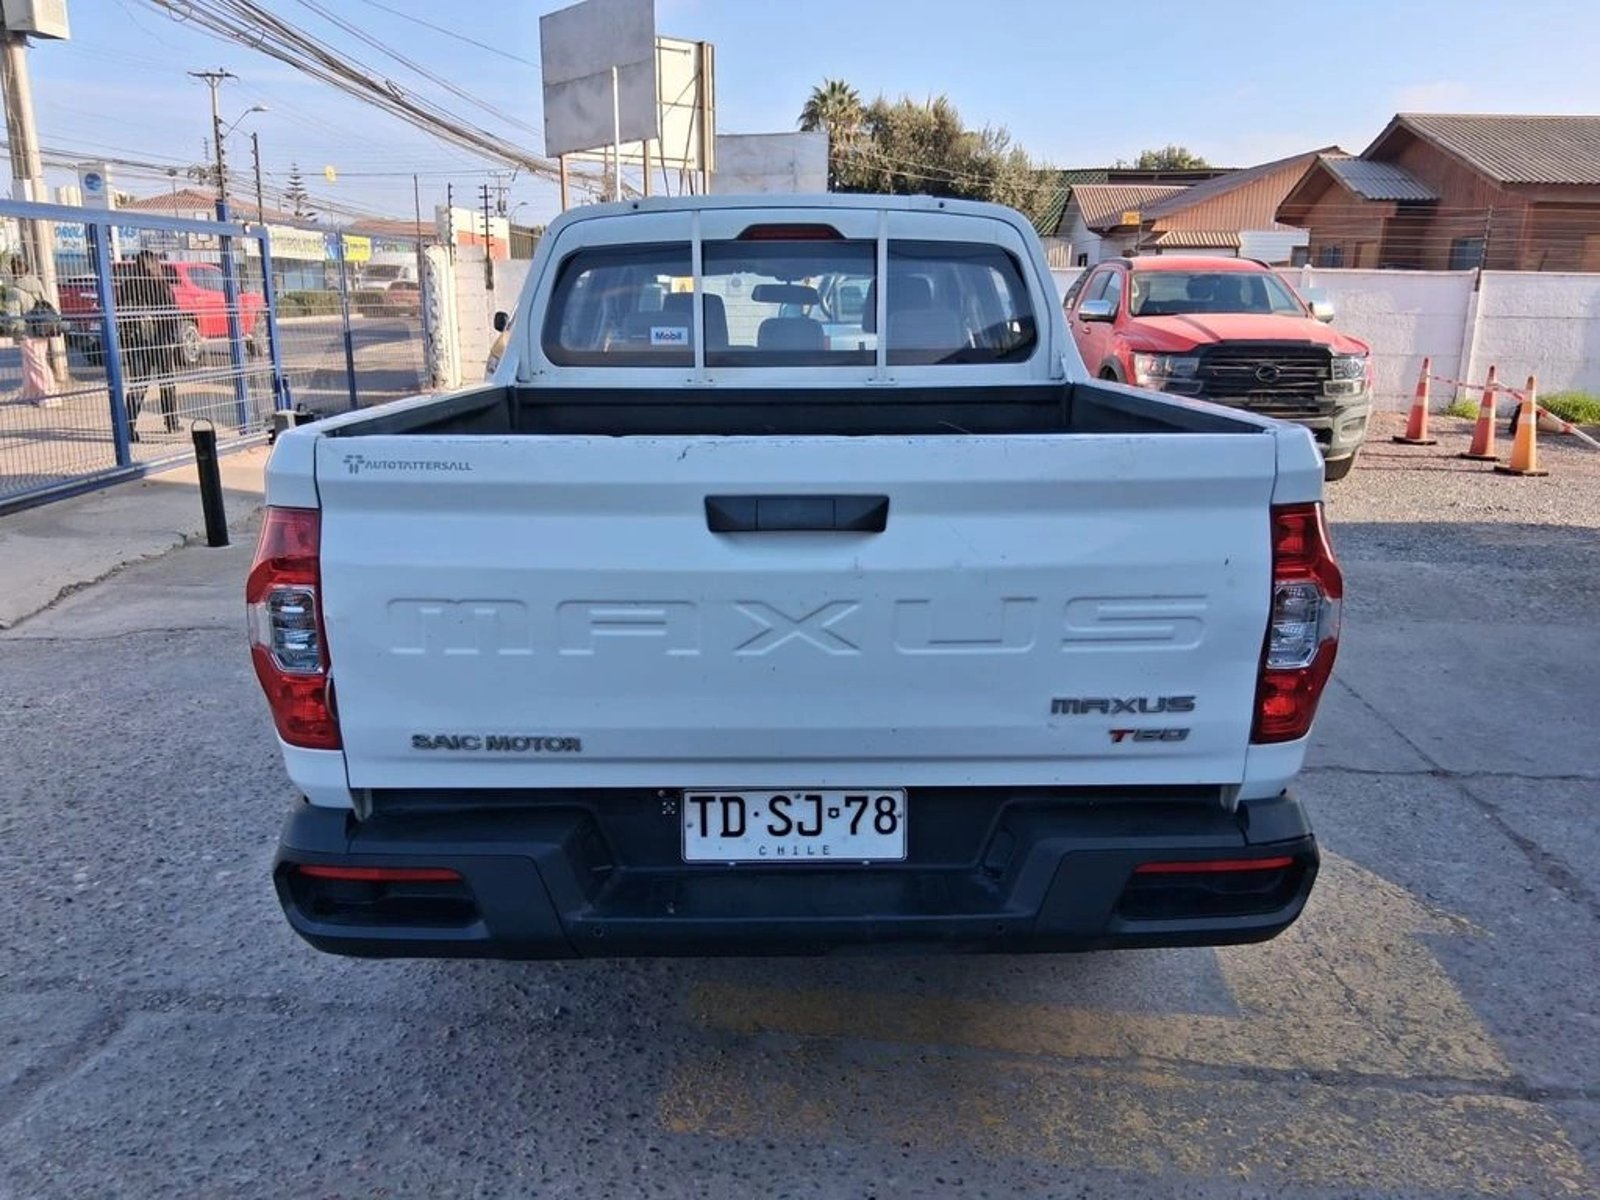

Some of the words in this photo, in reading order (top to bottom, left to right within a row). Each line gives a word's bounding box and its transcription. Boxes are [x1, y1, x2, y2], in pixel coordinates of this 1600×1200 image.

[655, 331, 682, 340] Mobil
[364, 460, 473, 471] AUTOTATTERSALL
[386, 595, 1209, 656] MAXUS
[1050, 695, 1196, 715] MAXUS
[411, 734, 482, 751] SAIC
[485, 735, 582, 752] MOTOR
[1108, 728, 1191, 744] T60
[758, 844, 832, 857] CHILE
